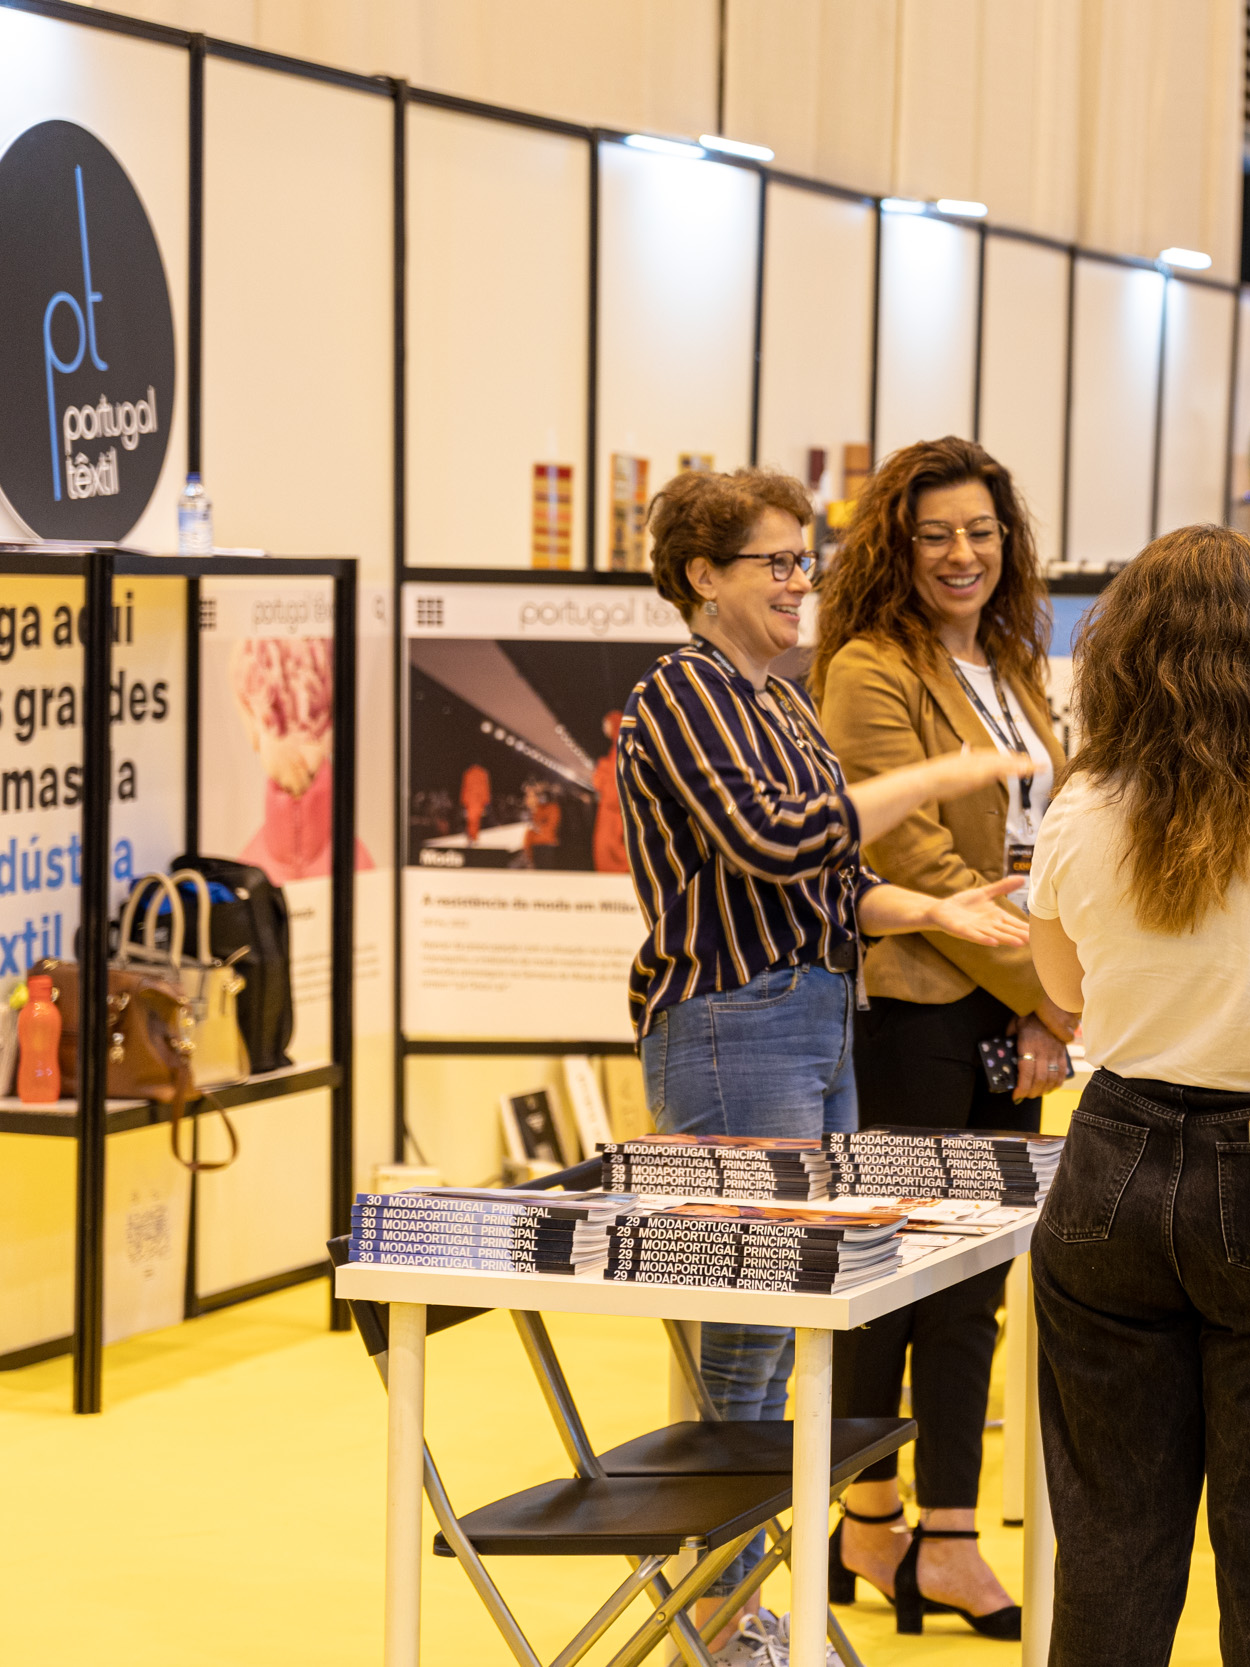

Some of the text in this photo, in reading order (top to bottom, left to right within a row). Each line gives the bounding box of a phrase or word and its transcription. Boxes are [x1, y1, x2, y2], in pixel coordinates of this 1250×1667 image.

[63, 385, 157, 454] portugal
[66, 446, 120, 500] têxtil
[53, 590, 134, 647] ai
[519, 597, 634, 637] portugal
[14, 670, 169, 742] grades
[0, 834, 134, 894] dústa
[604, 1144, 768, 1160] 29 MODAPORTUGAL PRINCIPAL
[830, 1144, 996, 1160] 30 MODAPORTUGAL PRINCIPAL
[831, 1134, 995, 1150] 30 MODAPORTUGAL PRINCIPAL
[610, 1155, 773, 1171] 29 MODAPORTUGAL PRINCIPAL
[835, 1154, 1000, 1170] 30 MODAPORTUGAL PRINCIPAL
[839, 1164, 1004, 1180] 30 MODAPORTUGAL PRINCIPAL
[611, 1174, 778, 1190] 29 MODAPORTUGAL PRINCIPAL
[612, 1165, 777, 1181] 29 MODAPORTUGAL PRINCIPAL
[841, 1174, 1007, 1190] 30 MODAPORTUGAL PRINCIPAL
[611, 1184, 776, 1200] 29 MODAPORTUGAL PRINCIPAL
[836, 1184, 849, 1193] 30
[856, 1184, 944, 1197] MODAPORTUGAL
[948, 1189, 1002, 1200] PRINCIPAL
[367, 1195, 551, 1217] 30 MODAPORTUGAL PRINCIPAL
[362, 1207, 540, 1228] 30 MODAPORTUGAL PRINCIPAL
[626, 1217, 808, 1238] 29 MODAPORTUGAL PRINCIPAL
[362, 1218, 538, 1239] 30 MODAPORTUGAL PRINCIPAL
[616, 1226, 801, 1248] 29 MODAPORTUGAL PRINCIPAL
[362, 1229, 538, 1250] 30 MODAPORTUGAL PRINCIPAL
[620, 1238, 803, 1260] 29 MODAPORTUGAL PRINCIPAL
[359, 1241, 535, 1261] 30 MODAPORTUGAL PRINCIPAL
[618, 1249, 803, 1271] 29 MODAPORTUGAL PRINCIPAL
[359, 1253, 539, 1273] 30 MODAPORTUGAL PRINCIPAL
[618, 1260, 799, 1281] 29 MODAPORTUGAL PRINCIPAL
[613, 1271, 795, 1292] 29 MODAPORTUGAL PRINCIPAL
